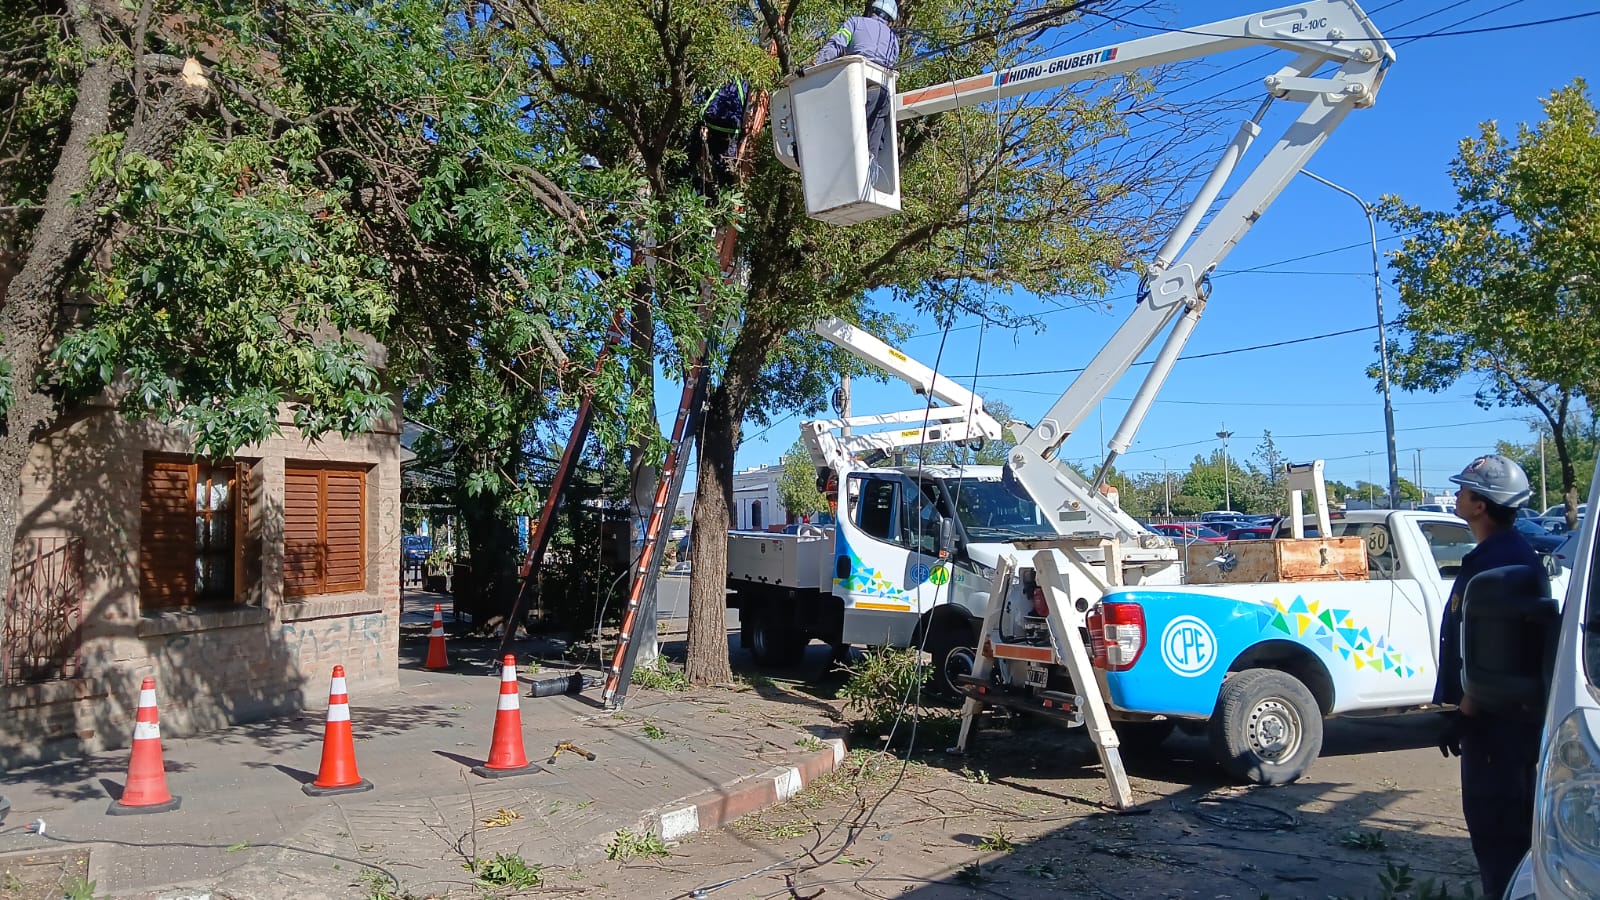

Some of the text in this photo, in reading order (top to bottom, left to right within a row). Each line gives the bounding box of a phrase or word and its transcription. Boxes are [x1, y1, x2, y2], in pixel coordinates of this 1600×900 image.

[1291, 17, 1328, 34] BL-10/C
[1008, 51, 1102, 83] HIDRO-GRUBERT
[1369, 532, 1386, 550] 80
[1170, 627, 1206, 665] CPE
